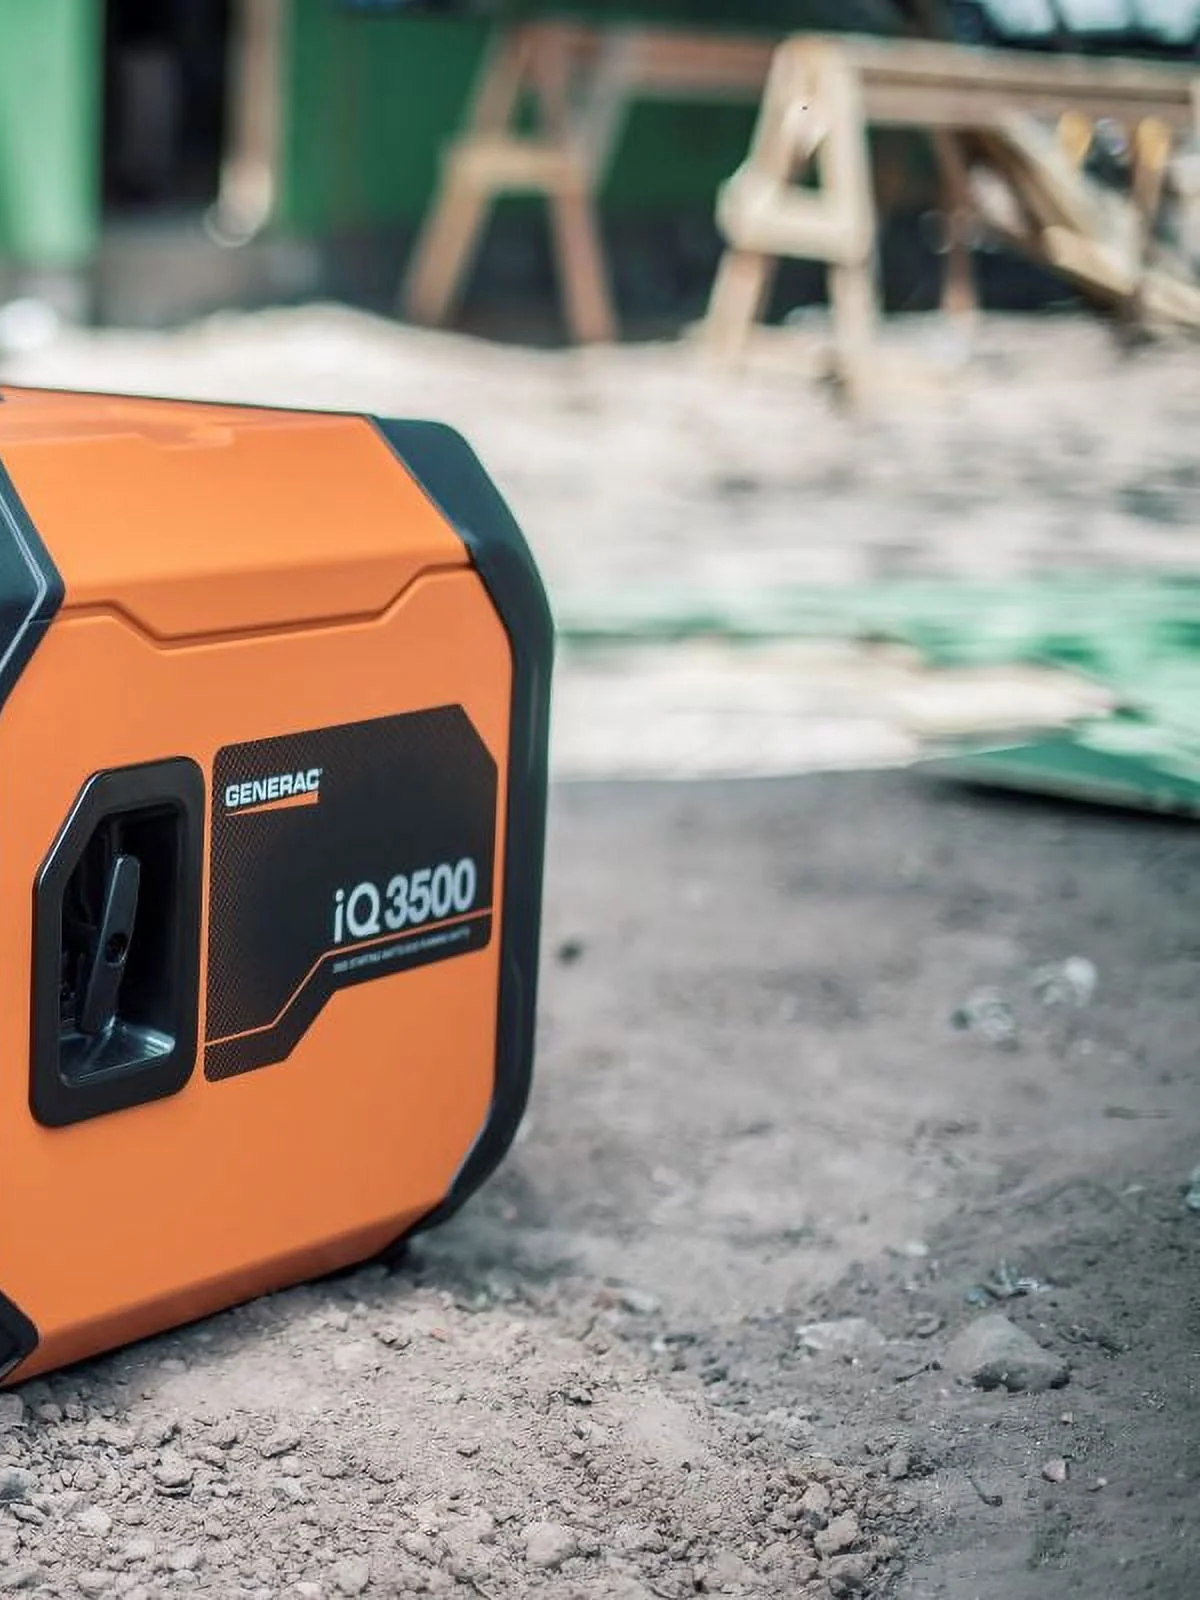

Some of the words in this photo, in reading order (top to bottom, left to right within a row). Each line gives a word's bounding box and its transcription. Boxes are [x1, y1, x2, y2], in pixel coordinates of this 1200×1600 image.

[225, 768, 321, 807] GENERAC
[334, 882, 380, 942] iQ
[384, 857, 476, 929] 3500
